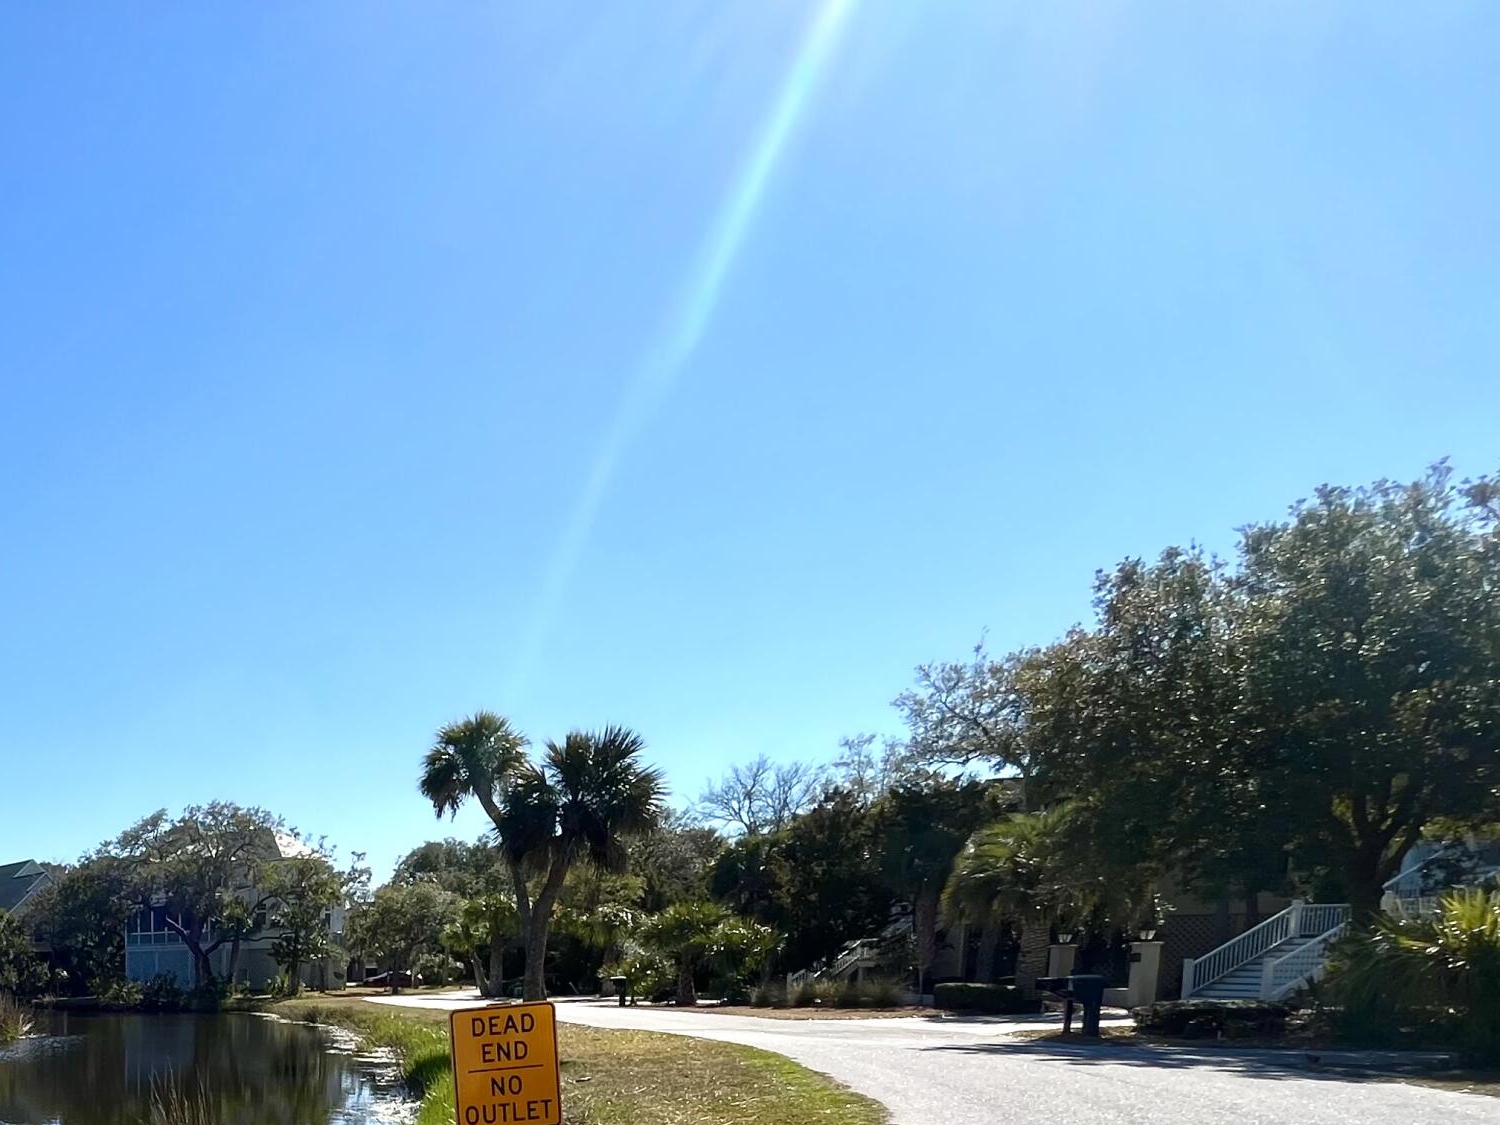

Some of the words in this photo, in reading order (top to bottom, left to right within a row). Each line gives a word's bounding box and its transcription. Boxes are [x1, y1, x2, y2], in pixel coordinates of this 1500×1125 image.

[471, 1013, 535, 1038] DEAD
[481, 1040, 528, 1064] END
[490, 1075, 523, 1097] NO
[465, 1099, 552, 1125] OUTLET
